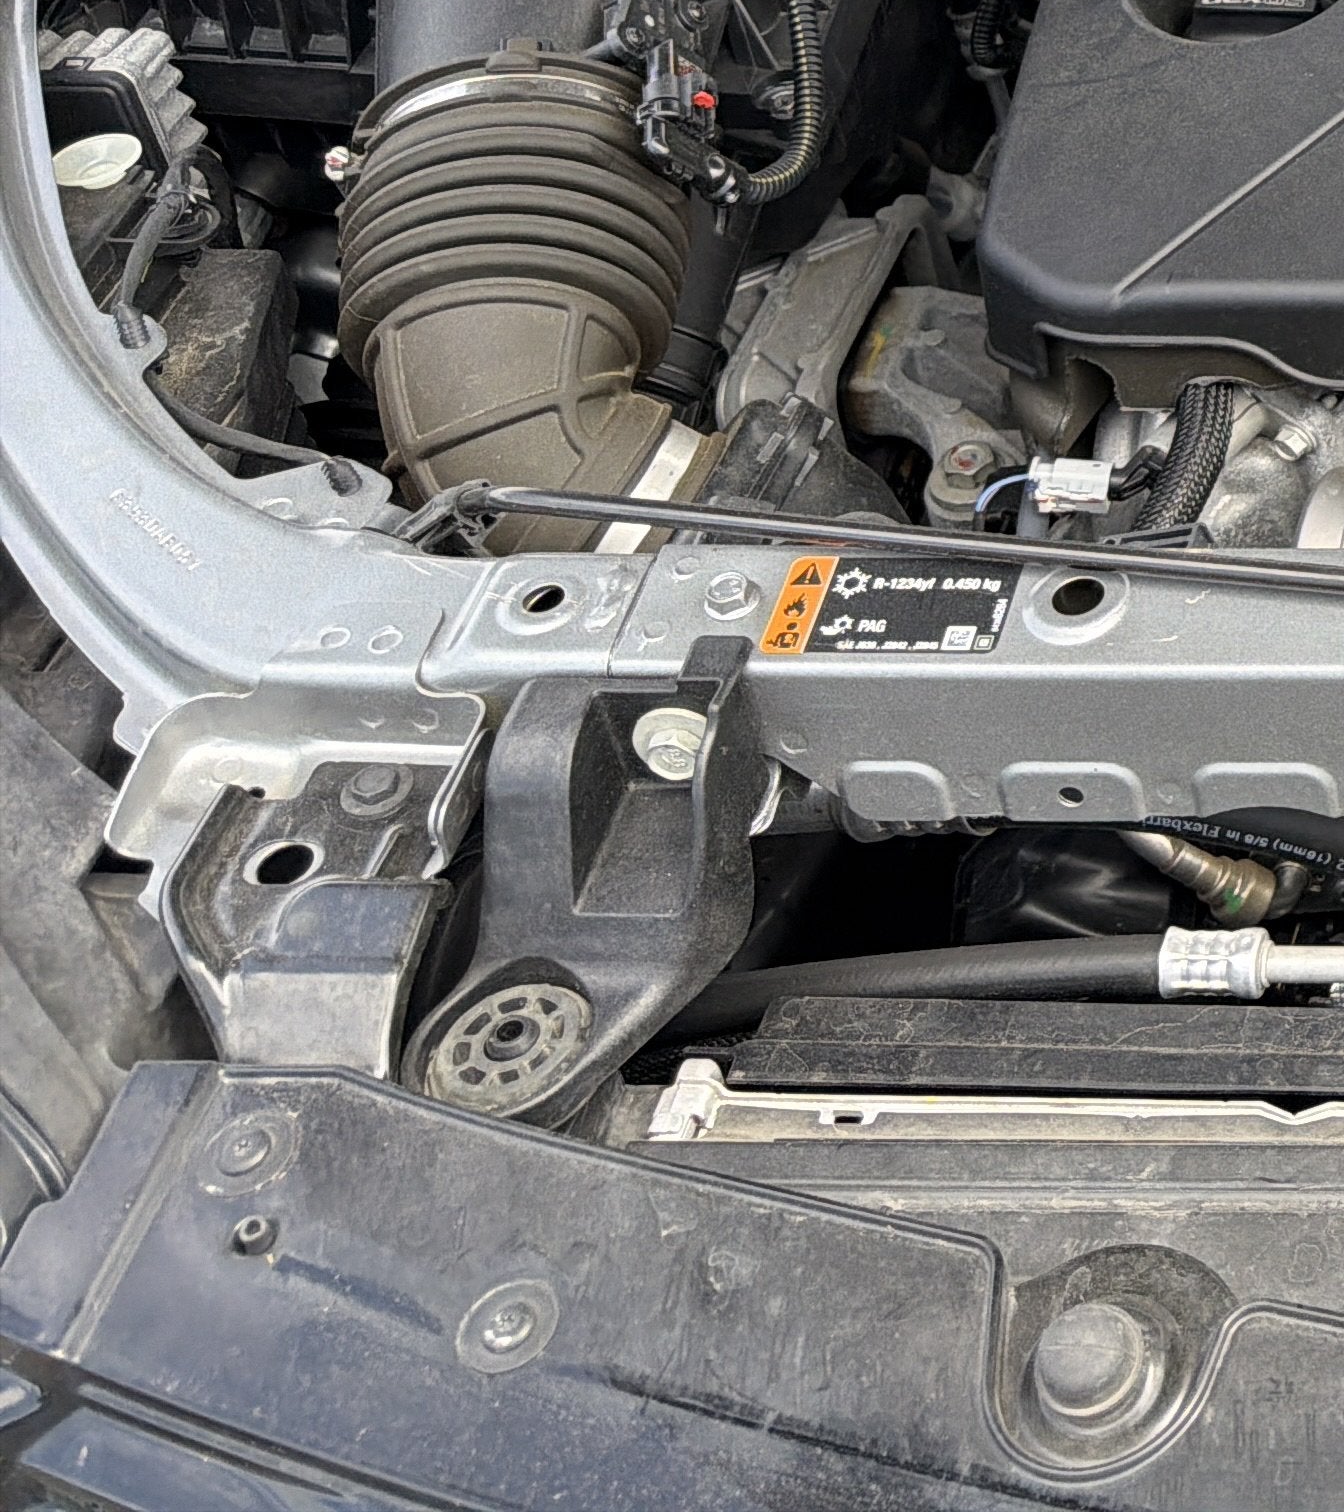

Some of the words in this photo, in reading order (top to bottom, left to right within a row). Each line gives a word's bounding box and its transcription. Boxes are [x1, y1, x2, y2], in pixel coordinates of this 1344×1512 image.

[942, 578, 982, 590] 0.450
[983, 578, 1002, 592] kg
[857, 618, 888, 634] PAG
[1272, 837, 1333, 865] (16mm)
